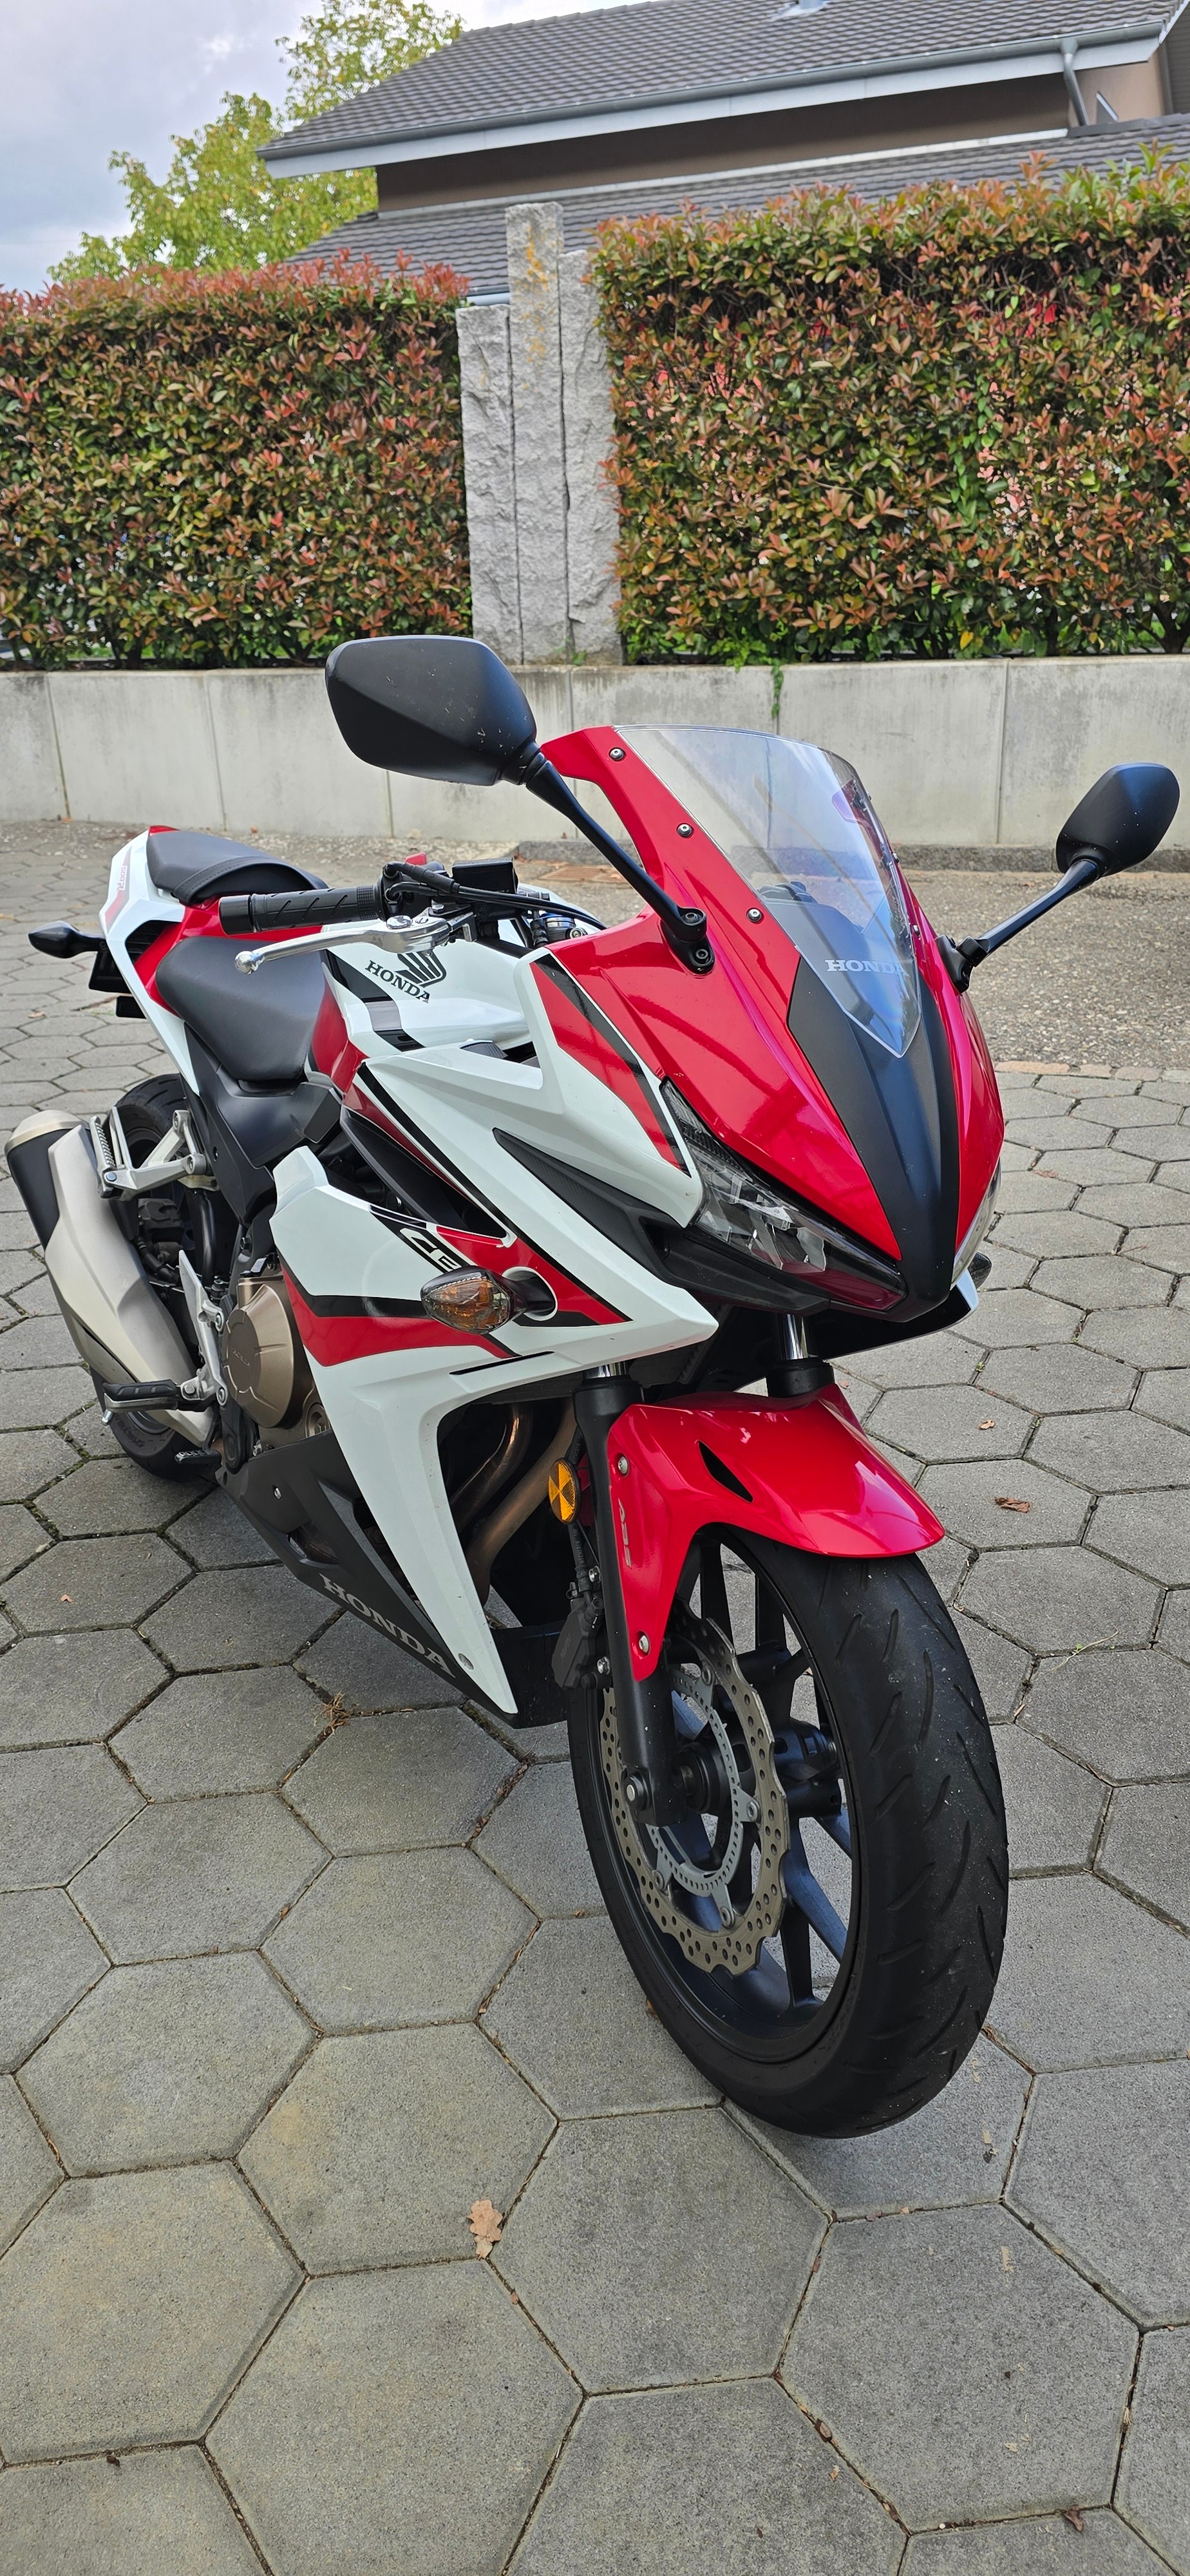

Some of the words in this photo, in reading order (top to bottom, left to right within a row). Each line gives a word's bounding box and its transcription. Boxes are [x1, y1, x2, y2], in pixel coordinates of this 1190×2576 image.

[117, 867, 126, 891] 500R
[364, 960, 431, 1003] HONDA
[825, 960, 911, 978] HONDA
[618, 1497, 632, 1567] ABS
[319, 1573, 456, 1678] HONDA
